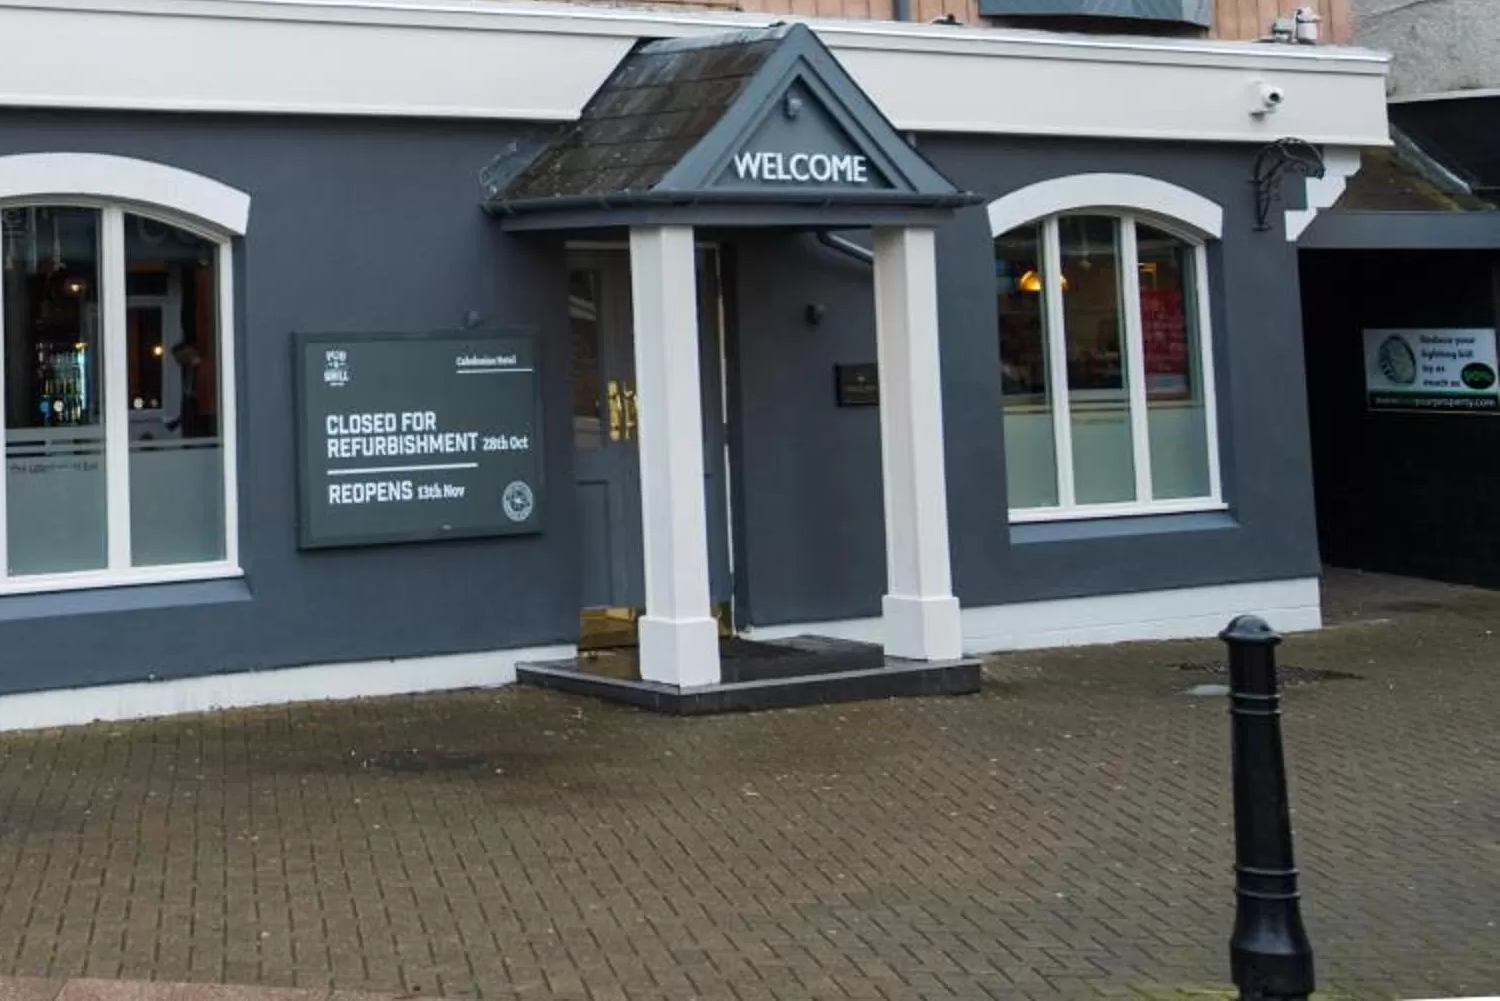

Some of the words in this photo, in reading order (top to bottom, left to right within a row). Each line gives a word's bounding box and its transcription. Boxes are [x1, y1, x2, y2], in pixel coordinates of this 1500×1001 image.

[733, 151, 869, 183] WELCOME
[326, 413, 396, 435] CLOSED
[401, 411, 437, 432] FOR
[327, 432, 479, 458] REFURBISHMENT
[483, 437, 508, 451] 28th
[510, 436, 529, 449] Oct
[328, 481, 413, 504] REOPENS
[443, 484, 465, 498] Nov
